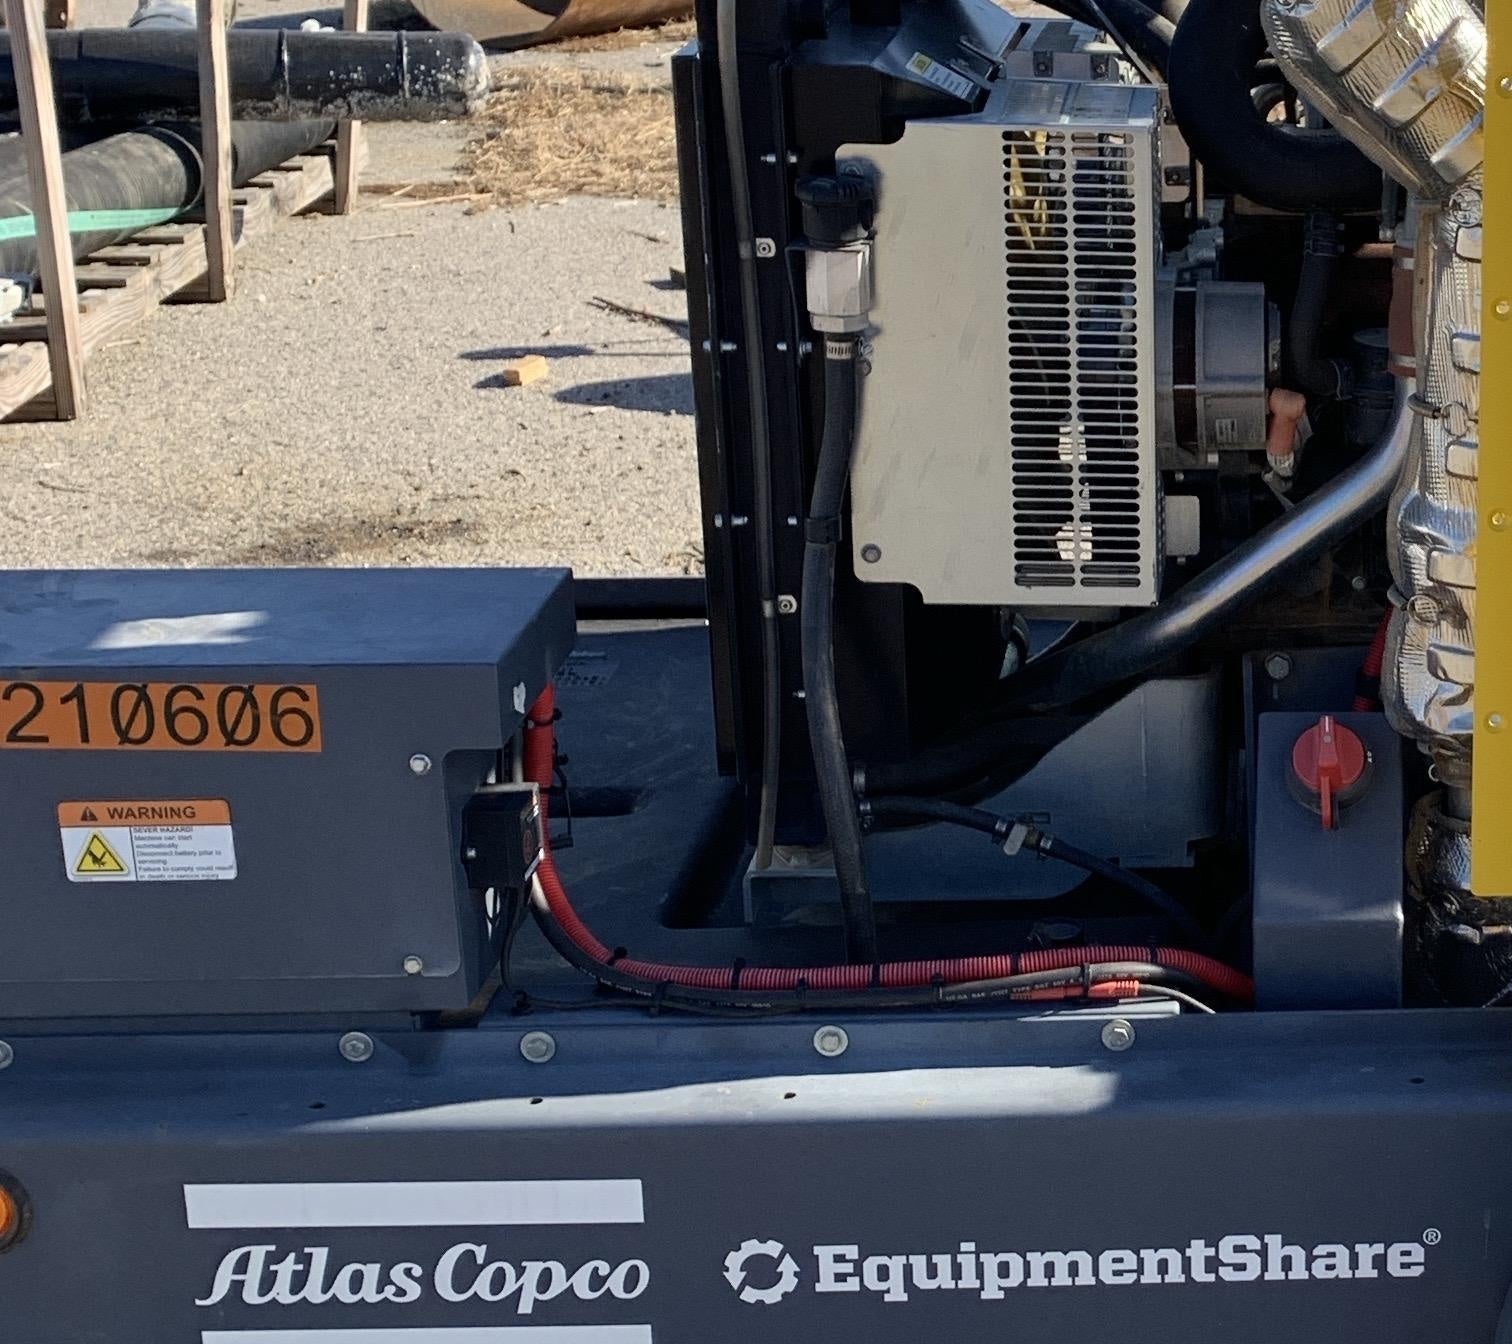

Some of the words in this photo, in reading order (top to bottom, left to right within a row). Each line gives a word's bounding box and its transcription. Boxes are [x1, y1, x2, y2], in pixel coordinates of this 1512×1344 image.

[1, 681, 316, 748] 210606
[107, 806, 196, 819] WARNING
[194, 1244, 423, 1307] Atlas
[433, 1242, 651, 1315] Copco
